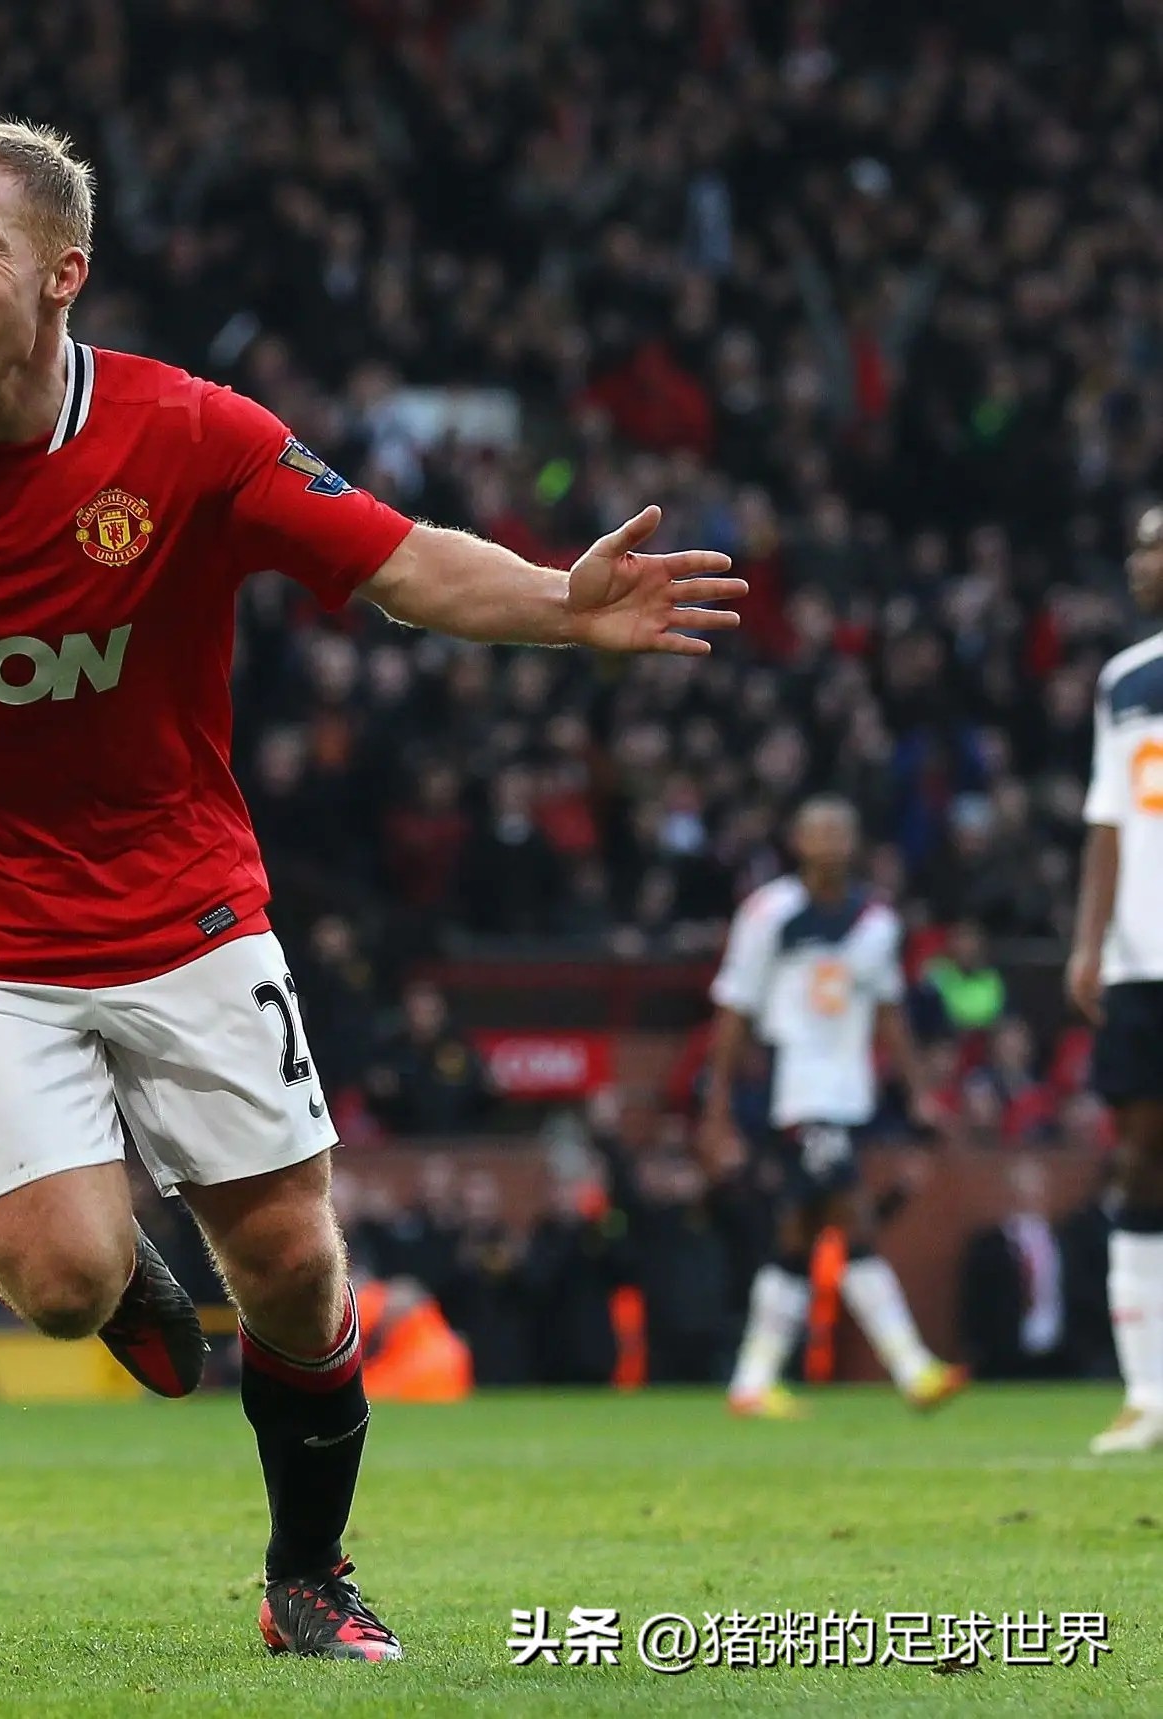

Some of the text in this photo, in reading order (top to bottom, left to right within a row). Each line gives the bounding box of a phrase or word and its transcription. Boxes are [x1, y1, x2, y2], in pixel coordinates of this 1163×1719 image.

[82, 493, 144, 523] MANCHESTER
[97, 545, 139, 561] UNITED
[250, 973, 313, 1087] 2
